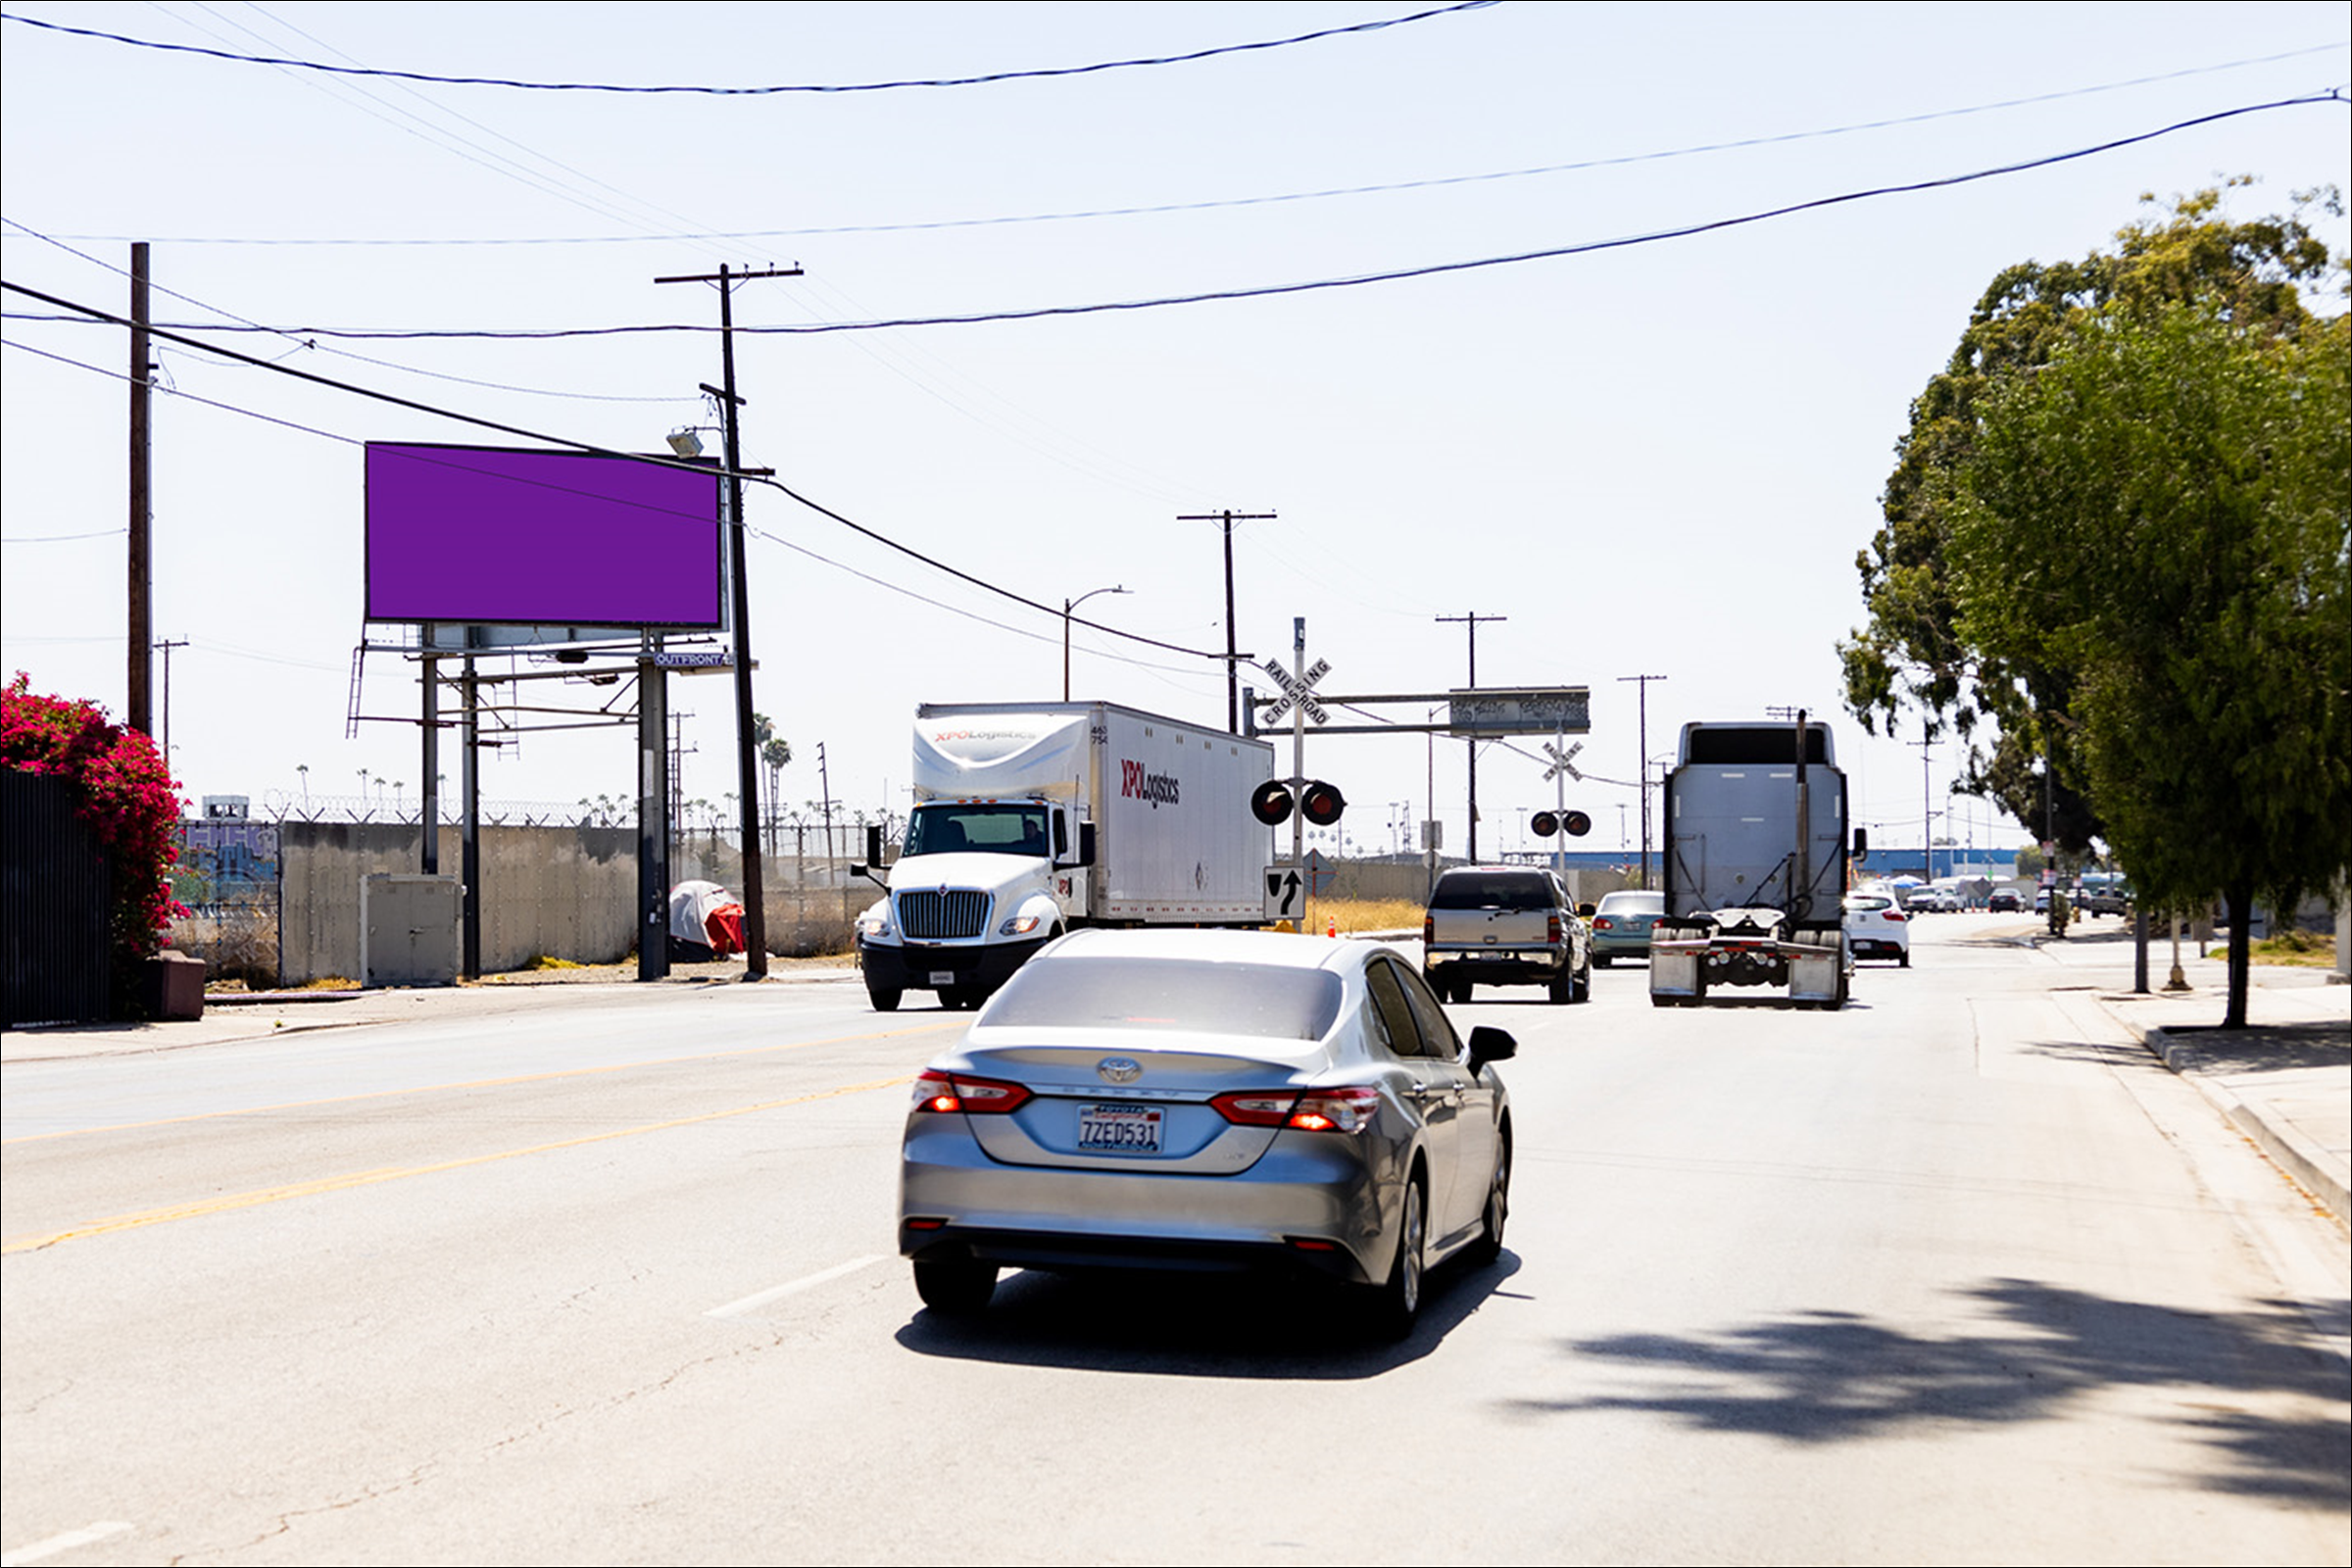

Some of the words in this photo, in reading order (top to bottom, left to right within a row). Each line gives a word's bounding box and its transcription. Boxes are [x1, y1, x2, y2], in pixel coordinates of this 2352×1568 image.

[656, 654, 721, 665] OUTFRONT
[1265, 662, 1328, 724] CROSSING
[1082, 1120, 1156, 1146] 7ZED531
